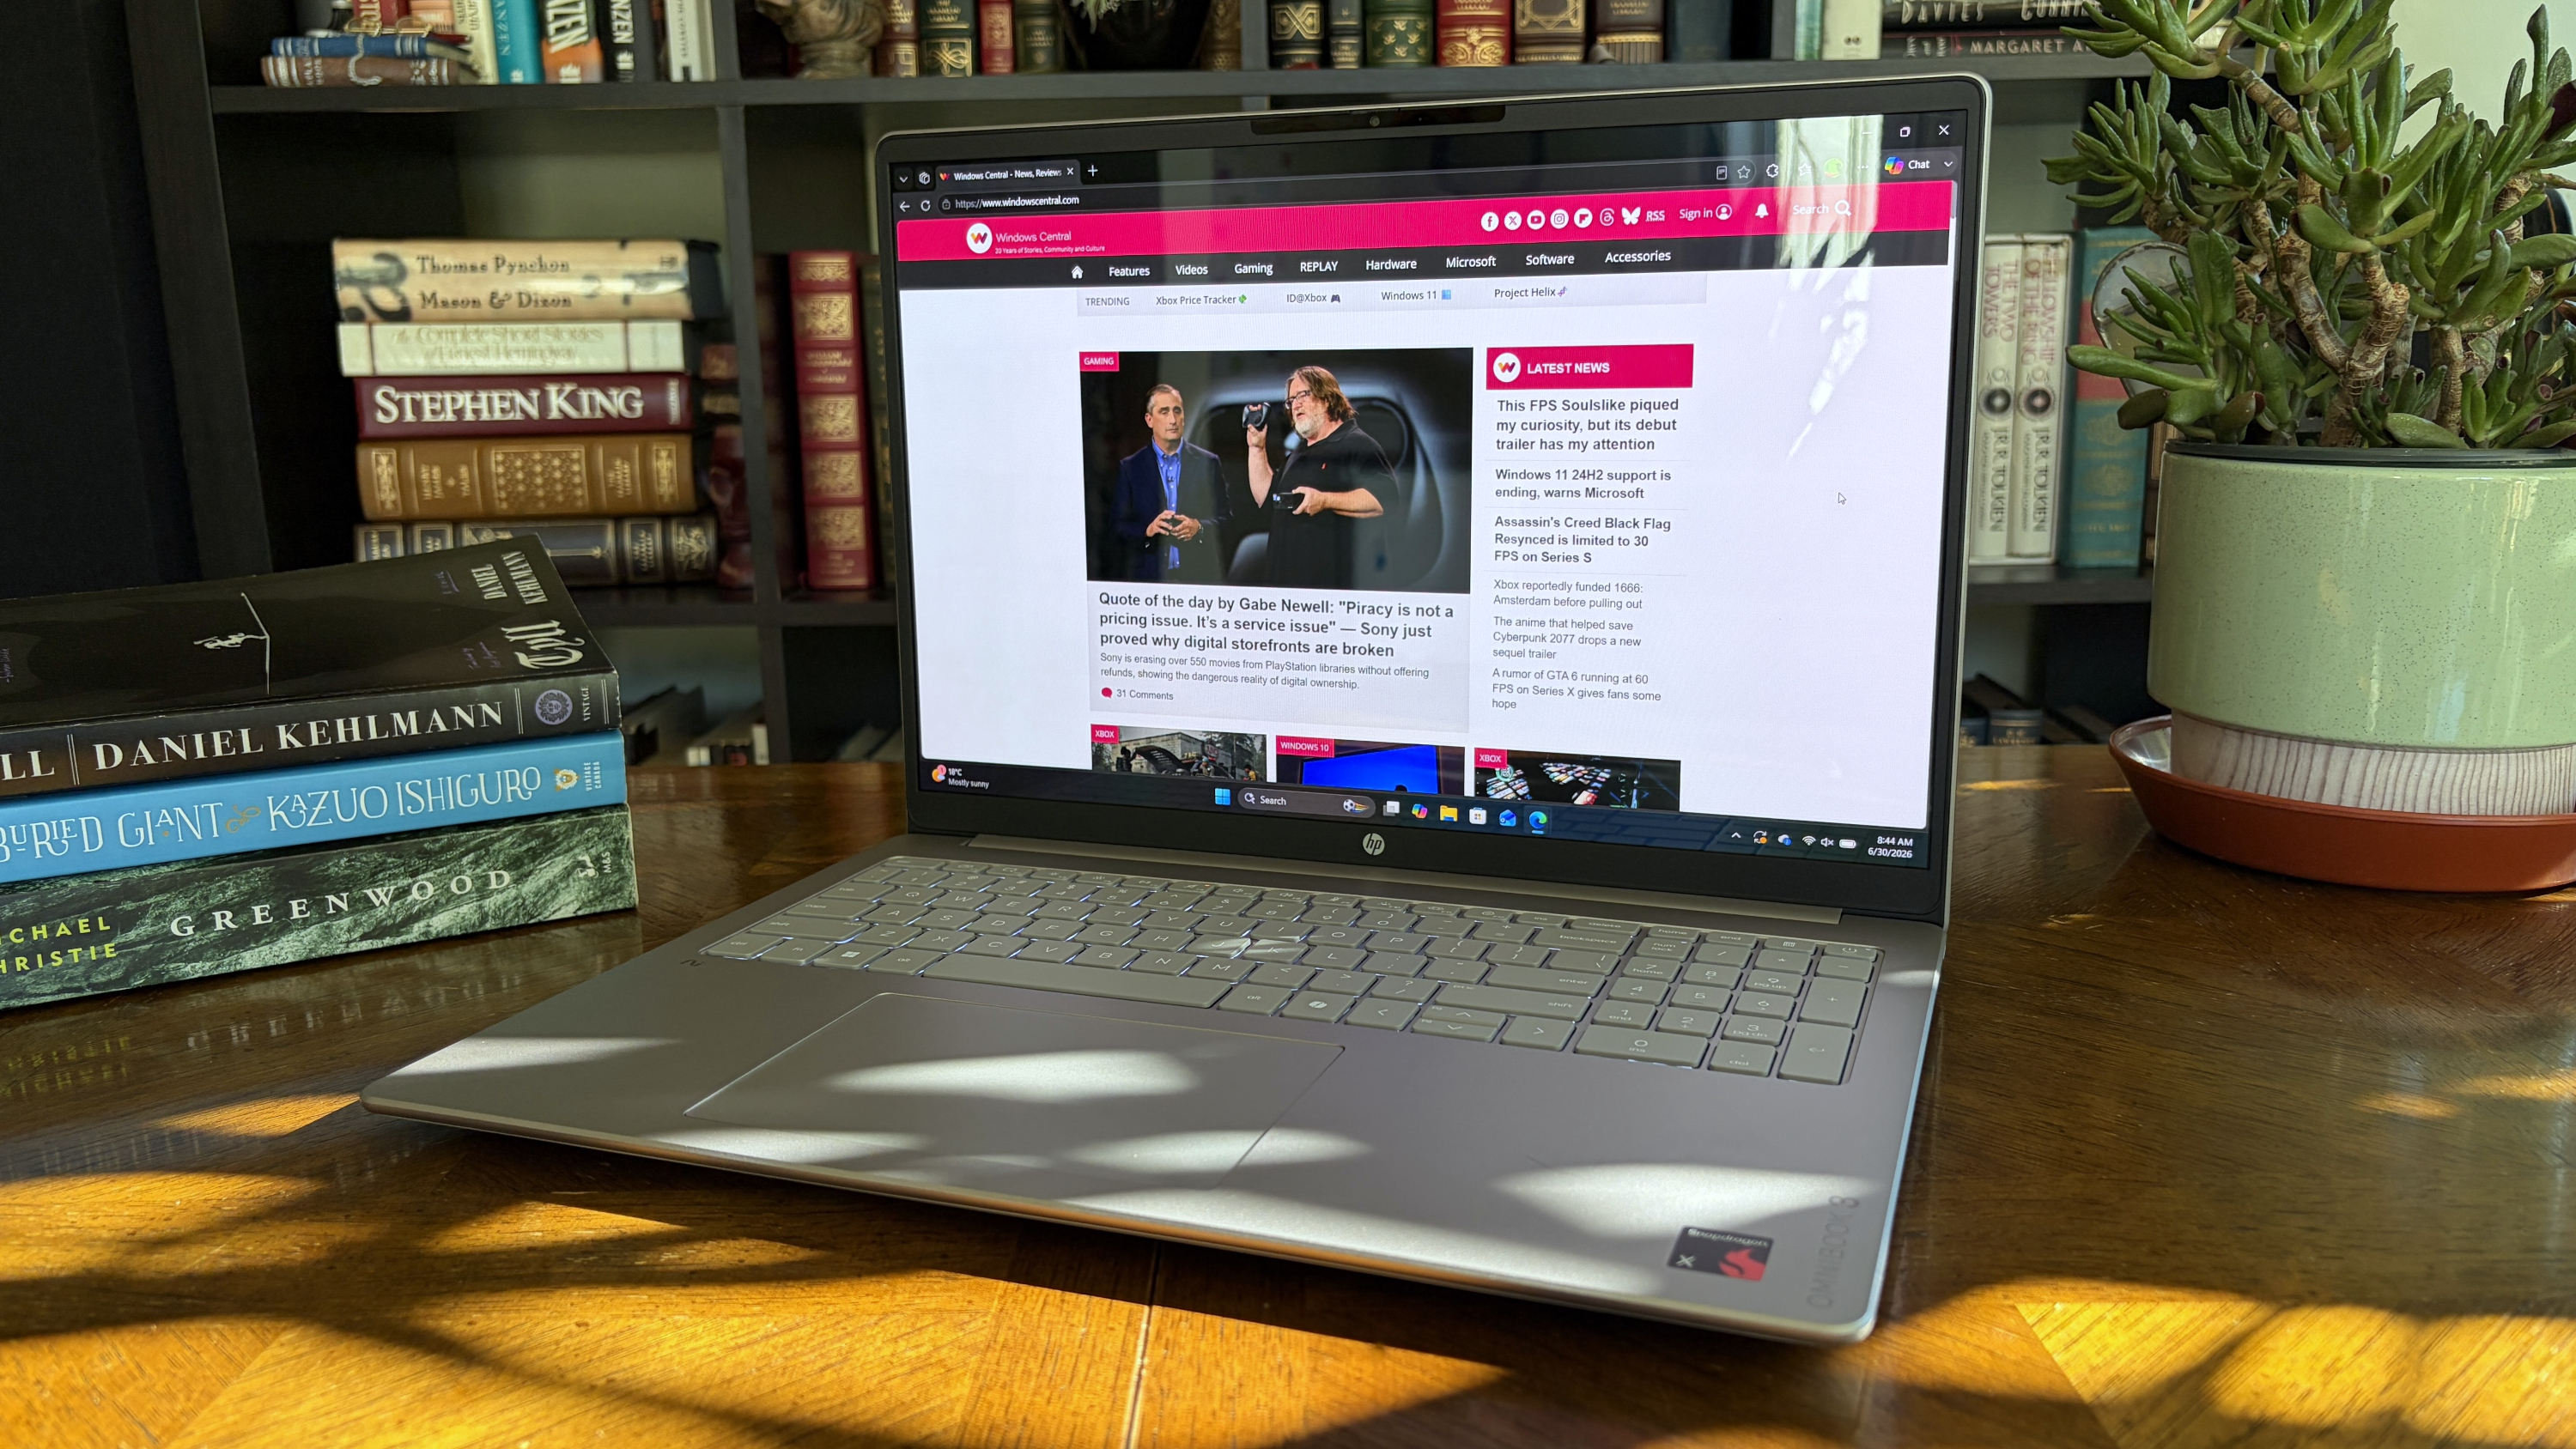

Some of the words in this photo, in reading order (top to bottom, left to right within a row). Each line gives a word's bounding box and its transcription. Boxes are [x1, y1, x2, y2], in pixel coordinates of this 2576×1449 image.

[1901, 0, 1984, 25] DAVIES
[1970, 39, 2065, 55] MARGARET
[1908, 157, 1931, 171] Chat
[954, 172, 984, 181] Windows
[985, 170, 1009, 179] Central
[1014, 169, 1035, 179] News,
[1036, 168, 1062, 178] Reviews
[955, 195, 1079, 209] https://www.windowscentral.com
[1792, 202, 1830, 216] Search
[1645, 209, 1666, 222] RSS
[1679, 207, 1701, 221] Sign
[1703, 207, 1714, 219] in
[996, 233, 1037, 243] Windows
[1039, 231, 1072, 242] Central
[416, 254, 489, 275] Thomas
[494, 253, 570, 276] Pynchon
[1108, 264, 1151, 280] Features
[1174, 262, 1209, 277] Videos
[1234, 261, 1273, 277] Gaming
[1299, 259, 1339, 273] REPLAY
[1364, 257, 1418, 272] Hardware
[1445, 253, 1497, 270] Microsoft
[1525, 252, 1576, 267] Software
[1604, 249, 1672, 264] Accessories
[2002, 258, 2020, 294] THE
[419, 290, 482, 310] Mason
[489, 290, 513, 310] &
[517, 290, 573, 309] Dixon
[1084, 295, 1131, 307] TRENDING
[1155, 294, 1179, 306] Xbox
[1179, 294, 1202, 306] Price
[1203, 292, 1237, 306] Tracker
[1286, 291, 1327, 305] ID@Xbox
[1381, 289, 1425, 301] Windows
[1426, 289, 1438, 300] 11
[1493, 286, 1529, 300] Project
[1530, 285, 1557, 298] Helix
[1982, 264, 2000, 338] TOWERS
[2000, 294, 2017, 343] TWO
[1084, 356, 1115, 367] GAMING
[1527, 363, 1572, 374] LATEST
[1574, 362, 1610, 374] NEWS
[374, 385, 540, 424] STEPHEN
[544, 383, 645, 420] KING
[1498, 400, 1526, 412] This
[1529, 399, 1558, 411] FPS
[1561, 398, 1626, 411] Soulslike
[1630, 398, 1679, 413] piqued
[1497, 421, 1516, 434] my
[1521, 419, 1583, 433] curiosity,
[1588, 419, 1610, 431] but
[1614, 419, 1631, 431] its
[1636, 418, 1677, 431] debut
[1496, 439, 1535, 451] trailer
[1540, 439, 1564, 451] has
[1568, 440, 1589, 452] my
[1593, 439, 1655, 451] attention
[1495, 469, 1552, 481] Windows
[1555, 470, 1568, 481] 11
[1572, 469, 1603, 482] 24H2
[1607, 470, 1657, 483] support
[1660, 470, 1672, 482] is
[1495, 487, 1540, 500] ending,
[1544, 488, 1582, 499] warns
[1585, 487, 1644, 499] Microsoft
[471, 563, 508, 600] DANIEL
[501, 550, 549, 605] KEHLMANN
[1099, 592, 1140, 608] Quote
[1144, 593, 1160, 608] of
[1163, 593, 1184, 609] the
[1188, 595, 1214, 613] day
[1218, 596, 1235, 613] by
[1238, 597, 1278, 612] Gabe
[1281, 598, 1334, 614] Newell:
[1339, 600, 1394, 619] "Piracy
[1398, 603, 1411, 616] is
[1415, 603, 1441, 618] not
[1444, 606, 1454, 618] a
[1099, 612, 1148, 632] pricing
[1151, 614, 1194, 629] issue.
[1221, 619, 1230, 630] a
[1234, 618, 1286, 633] service
[1290, 620, 1336, 634] issue"
[1360, 621, 1399, 639] Sony
[1401, 624, 1432, 640] just
[1100, 633, 1148, 650] proved
[1151, 635, 1181, 651] why
[1183, 634, 1228, 652] digital
[1231, 637, 1310, 653] storefronts
[1315, 641, 1339, 655] are
[1342, 641, 1395, 658] broken
[1116, 688, 1127, 699] 31
[1129, 689, 1175, 700] Comments
[580, 685, 591, 722] VINTAGE
[93, 728, 265, 772] DANIEL
[276, 700, 506, 751] KEHLMANN
[1095, 729, 1115, 739] XBOX
[1279, 740, 1319, 752] WINDOWS
[1320, 743, 1329, 752] 10
[1479, 754, 1502, 763] XBOX
[583, 761, 592, 791] VINTAGE
[592, 761, 602, 790] CANADA
[948, 778, 969, 789] Mostly
[969, 779, 990, 791] sunny
[117, 802, 223, 848] GIANT
[266, 785, 389, 833] KAZUO
[398, 765, 542, 817] ISHIGURO
[1259, 794, 1287, 807] Search
[1876, 835, 1895, 846] 8:44
[1896, 837, 1914, 847] AM
[1867, 846, 1913, 859] 6/30/2026
[601, 851, 612, 874] M&S
[170, 868, 514, 940] GREENWOOD
[1588, 920, 1622, 930] delete
[1658, 928, 1688, 937] home
[1559, 933, 1618, 945] backspace
[1558, 977, 1589, 986] enter
[1547, 1001, 1574, 1009] shift
[1687, 1228, 1769, 1248] Snapdragon
[1675, 1254, 1697, 1269] X
